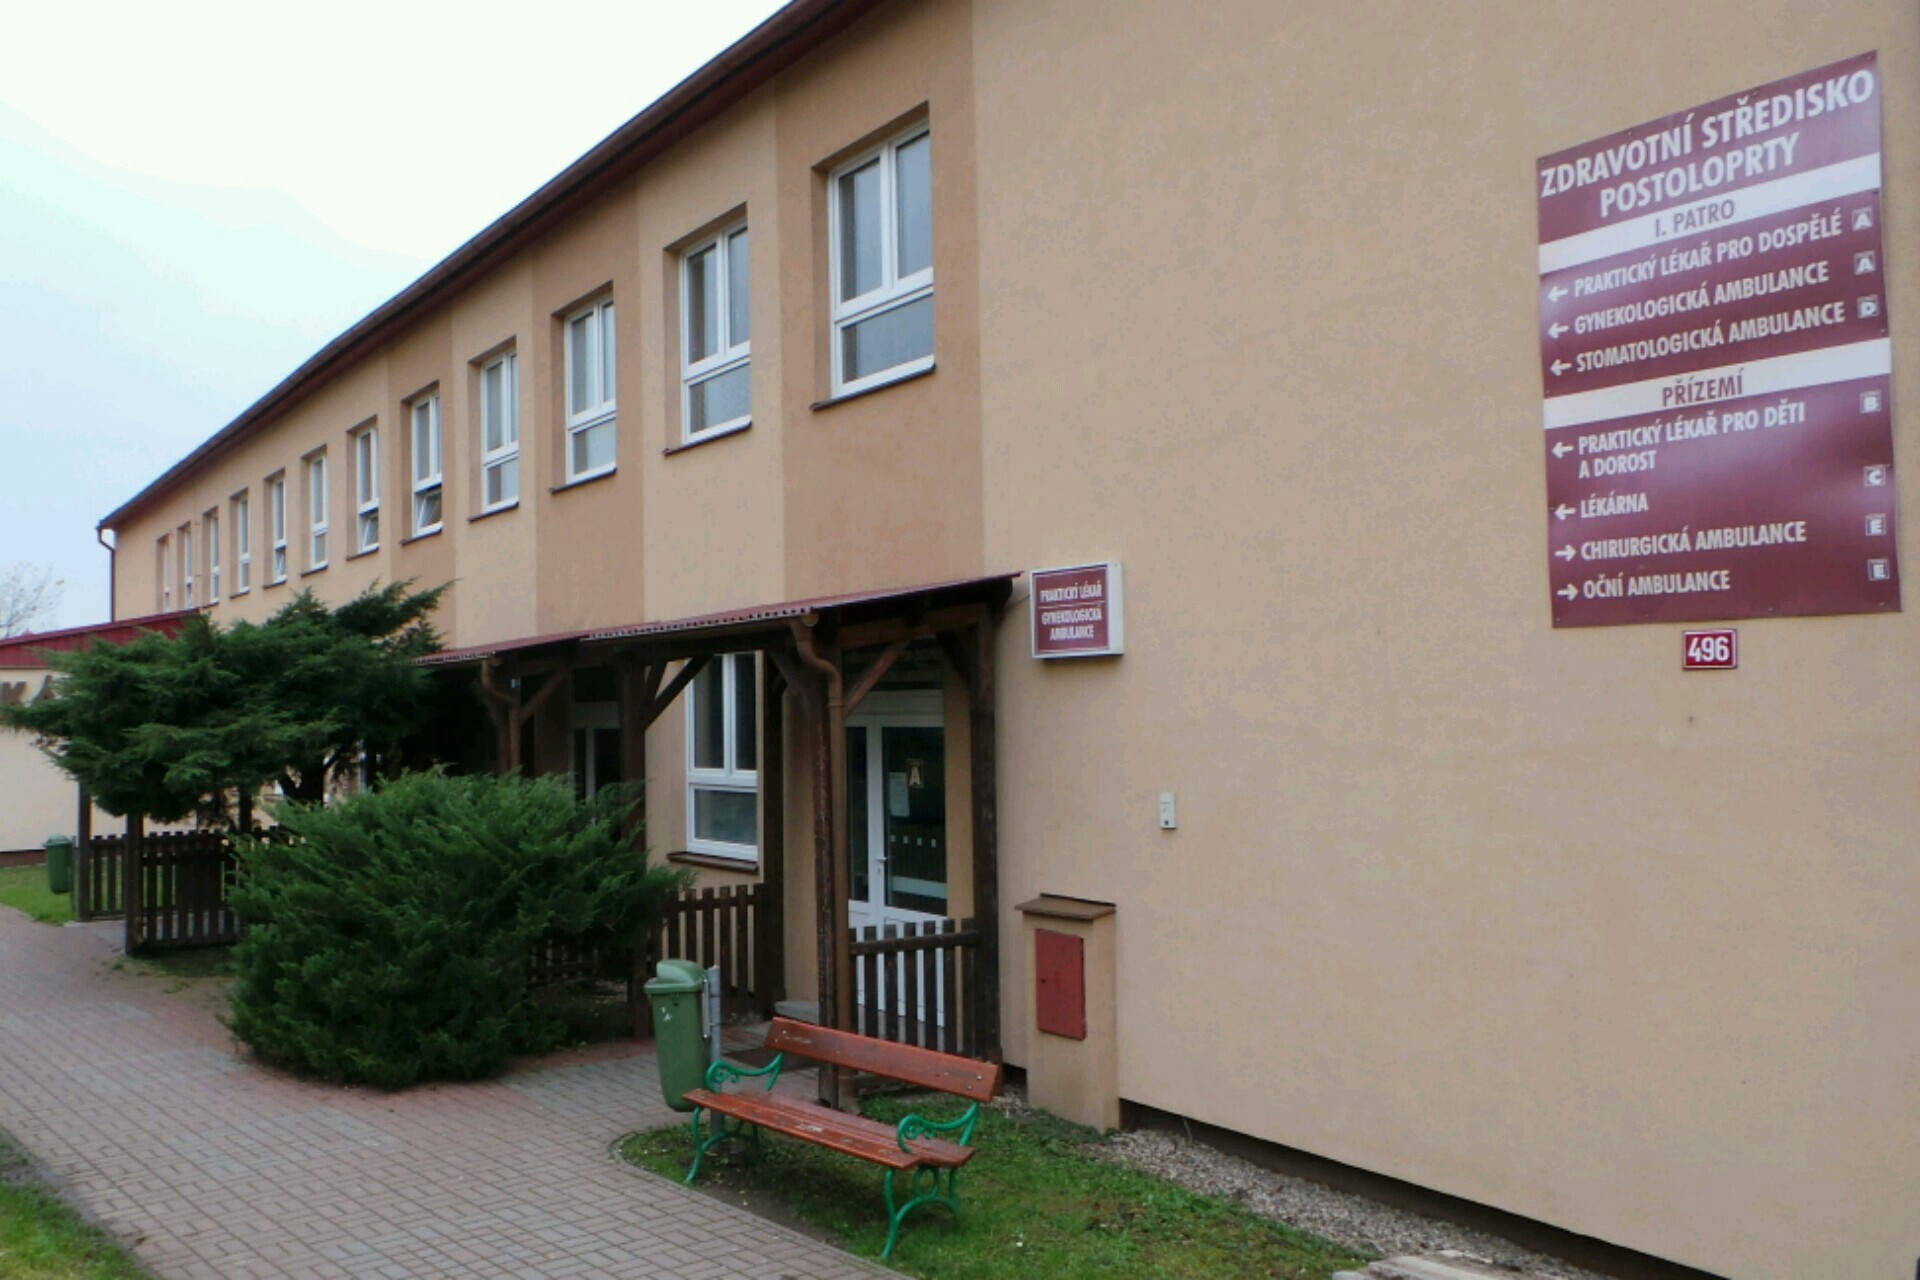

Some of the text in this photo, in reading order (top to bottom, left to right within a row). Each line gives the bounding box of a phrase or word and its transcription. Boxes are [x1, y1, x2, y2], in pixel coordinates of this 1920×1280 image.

[1540, 69, 1875, 198] ZDRAVOTNÍ STŘEDISKO
[1600, 131, 1800, 218] POSTOLOPRTY
[1655, 199, 1735, 238] I. PATRO
[1574, 207, 1873, 298] PRAKTICKÝ LÉKAŘ PRO DOSPĚLÉ A
[1574, 255, 1875, 335] GYNEKOLOGICKÁ AMBULANCE A
[1576, 319, 1725, 373] STOMATOLOGICKÁ
[1728, 301, 1846, 343] AMBULANCE
[1662, 367, 1744, 407] PŘÍZEMÍ
[1578, 418, 1662, 455] PRAKTICKÝ
[1665, 410, 1718, 442] LÉKAŘ
[1722, 410, 1759, 433] PRO
[1764, 398, 1806, 428] DĚTI
[1578, 450, 1657, 479] A DOROST
[1580, 468, 1883, 519] LÉKÁRNA C
[1580, 517, 1884, 561] CHIRURGICKÁ AMBULANCE E
[1583, 562, 1886, 599] OČNÍ AMBULANCE E
[1688, 636, 1730, 662] 496
